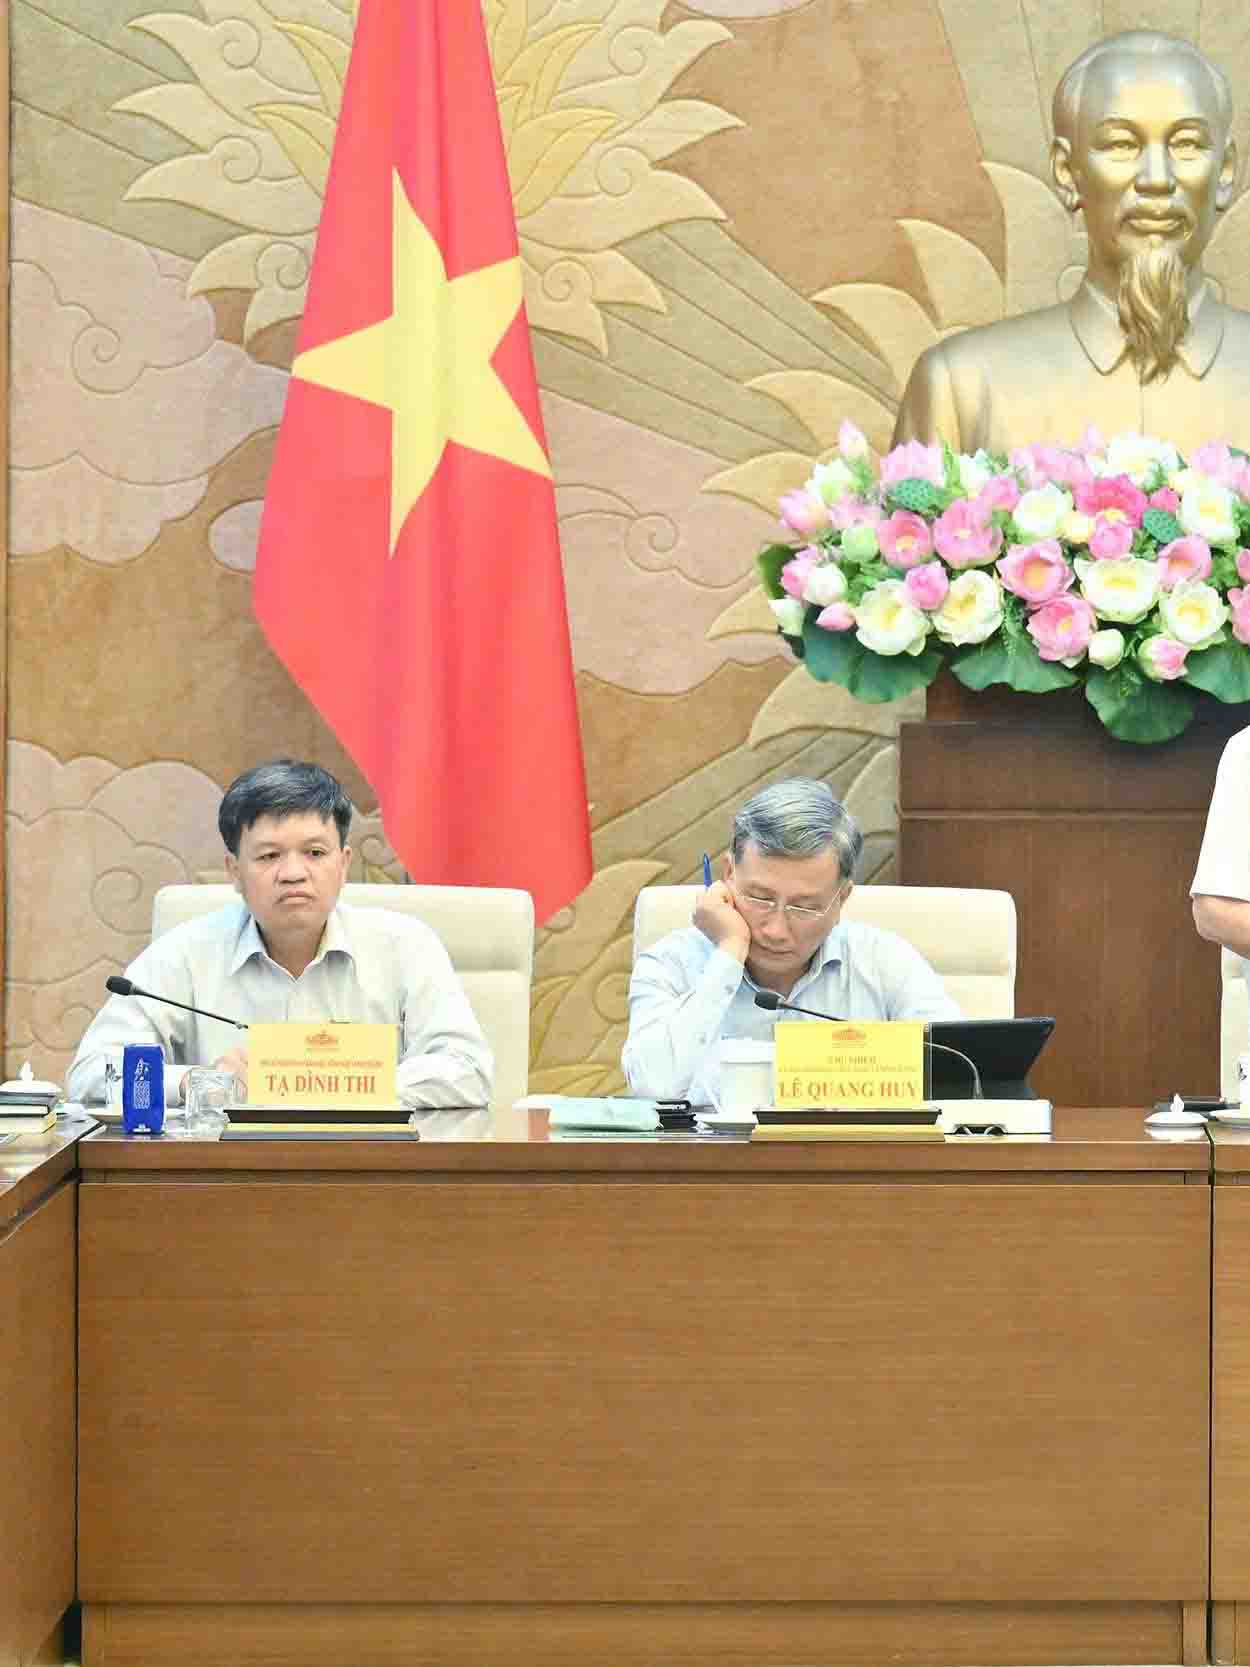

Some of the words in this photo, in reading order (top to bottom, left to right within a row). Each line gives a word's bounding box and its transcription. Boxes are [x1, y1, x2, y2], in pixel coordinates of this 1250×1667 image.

[265, 1074, 289, 1096] TẠ
[344, 1074, 376, 1093] THI
[807, 1080, 873, 1100] QUANG
